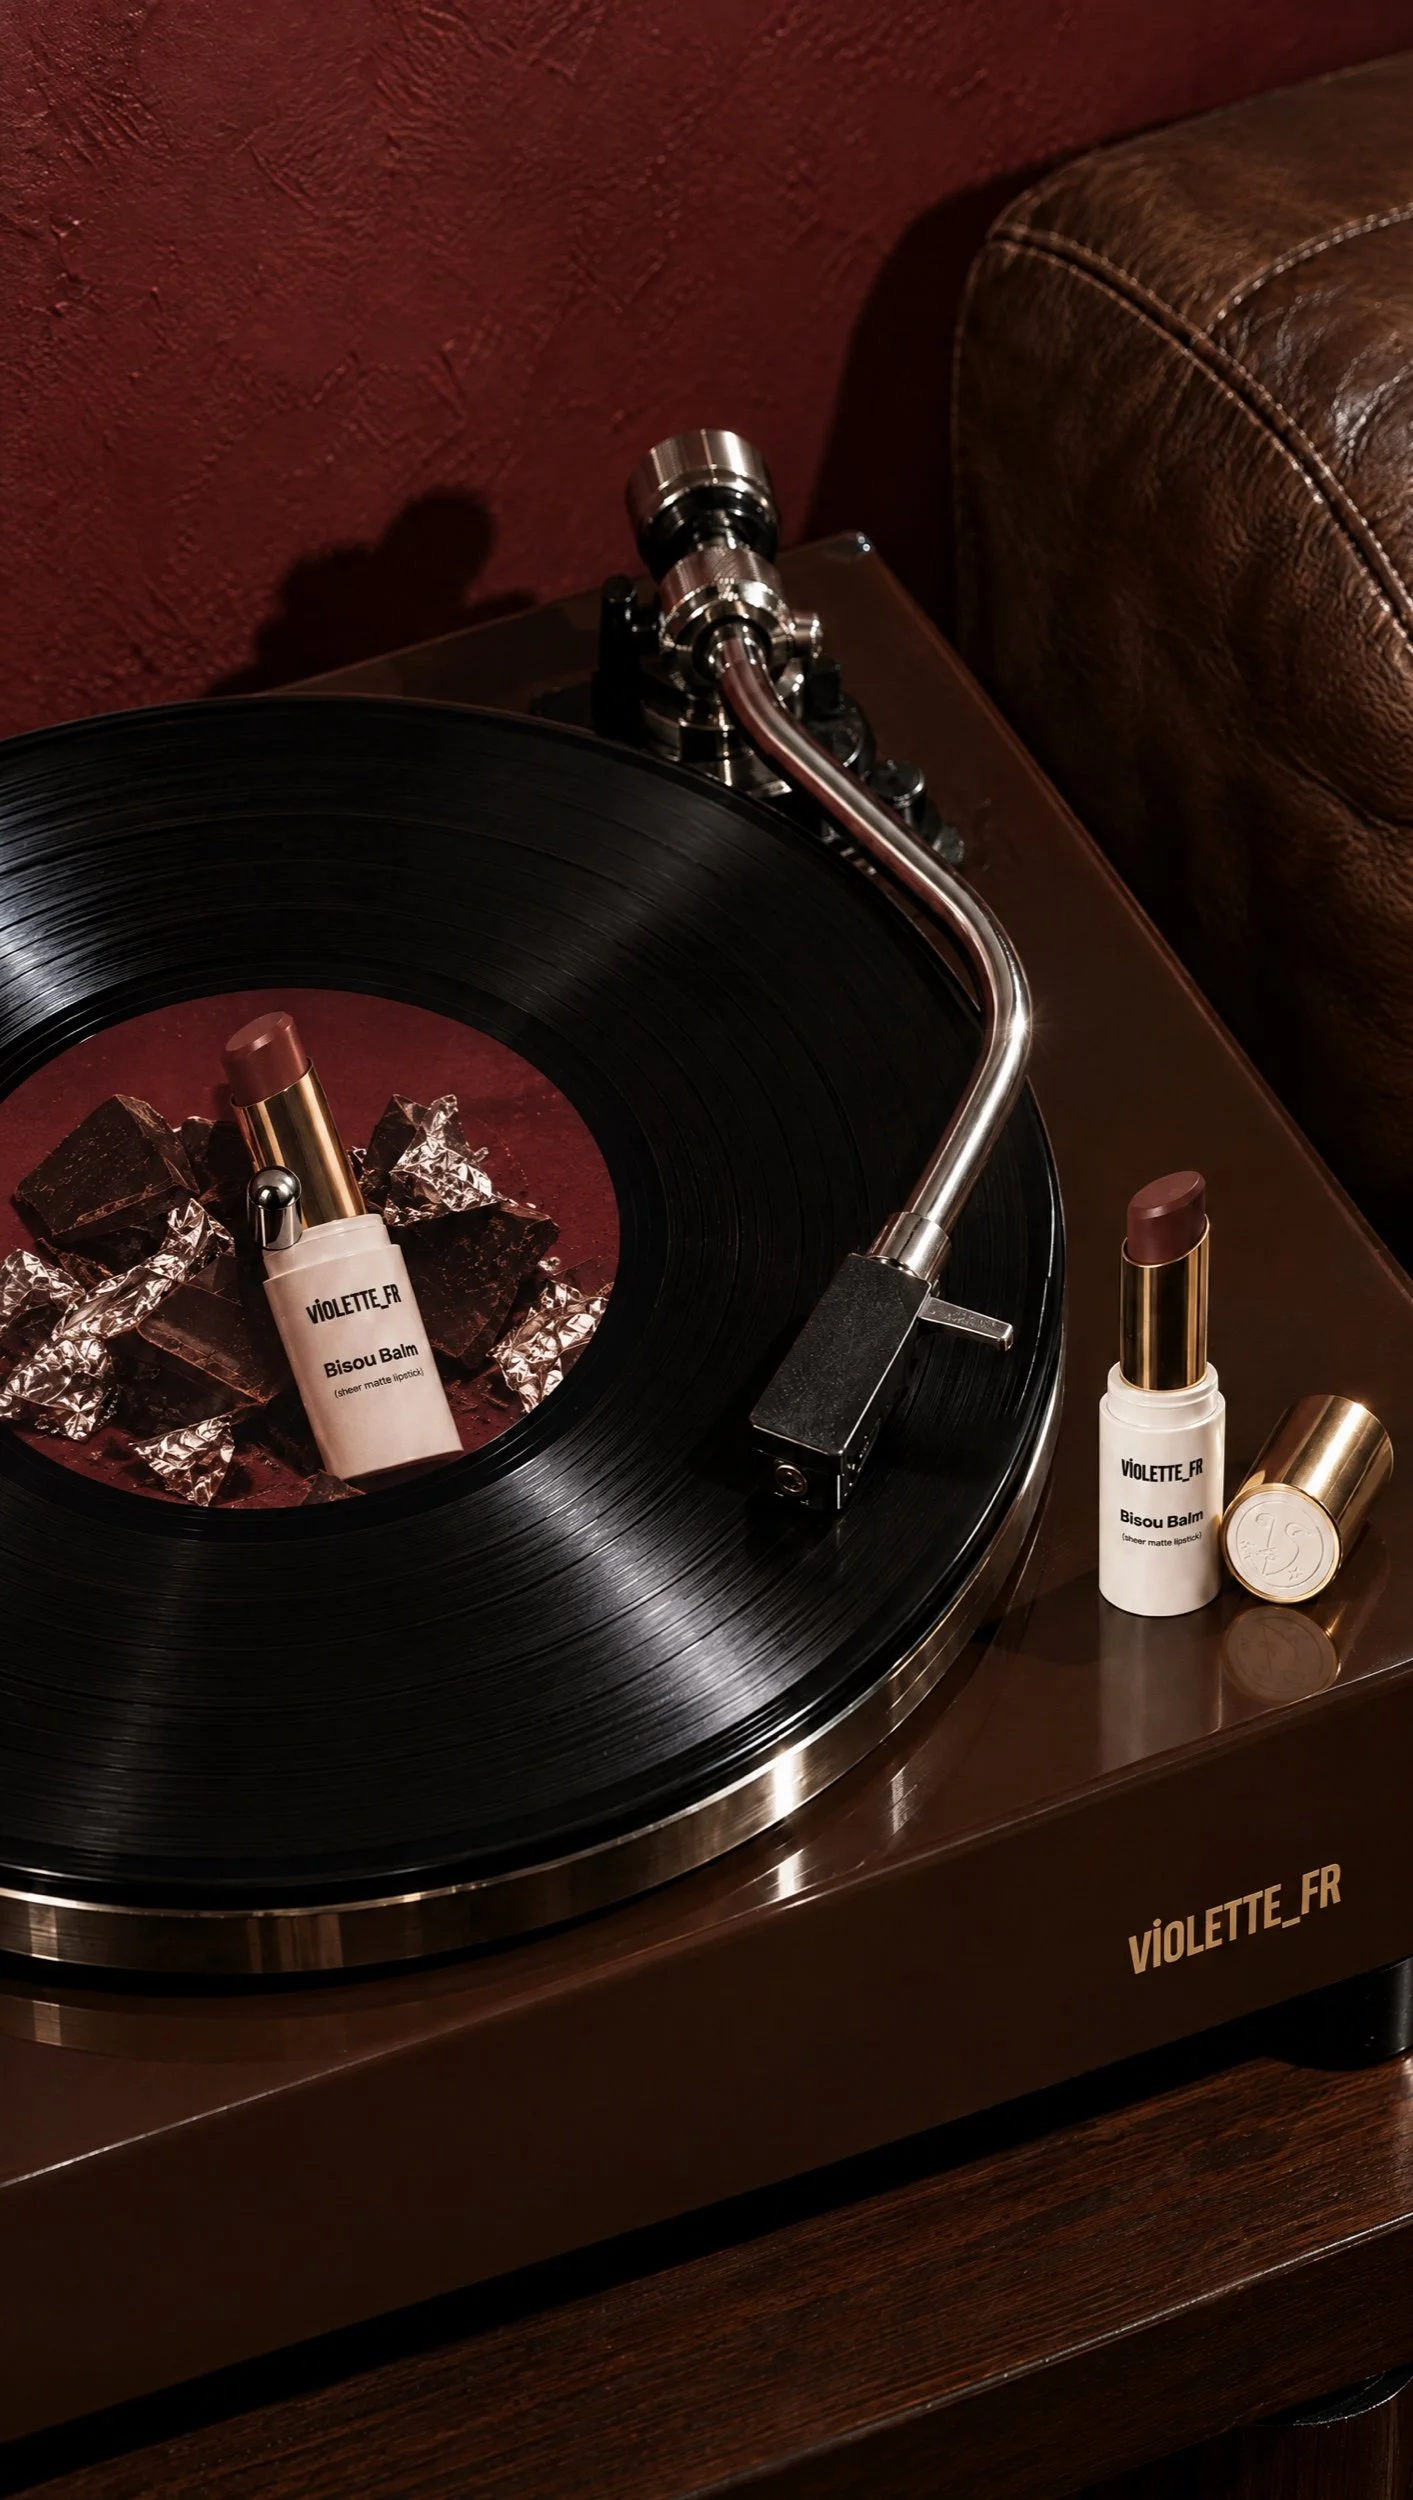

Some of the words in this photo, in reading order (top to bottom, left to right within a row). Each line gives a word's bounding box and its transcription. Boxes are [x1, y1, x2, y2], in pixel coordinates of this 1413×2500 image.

[323, 1353, 377, 1378] Bisou
[379, 1343, 419, 1363] Balm
[334, 1384, 362, 1399] (sheer
[364, 1375, 392, 1390] matte
[393, 1367, 425, 1383] lipstick)
[1120, 1509, 1163, 1528] Bisou
[1167, 1510, 1204, 1528] Balm
[1122, 1532, 1146, 1545] (sheer
[1148, 1536, 1172, 1547] matte
[1174, 1531, 1202, 1546] lipstick)
